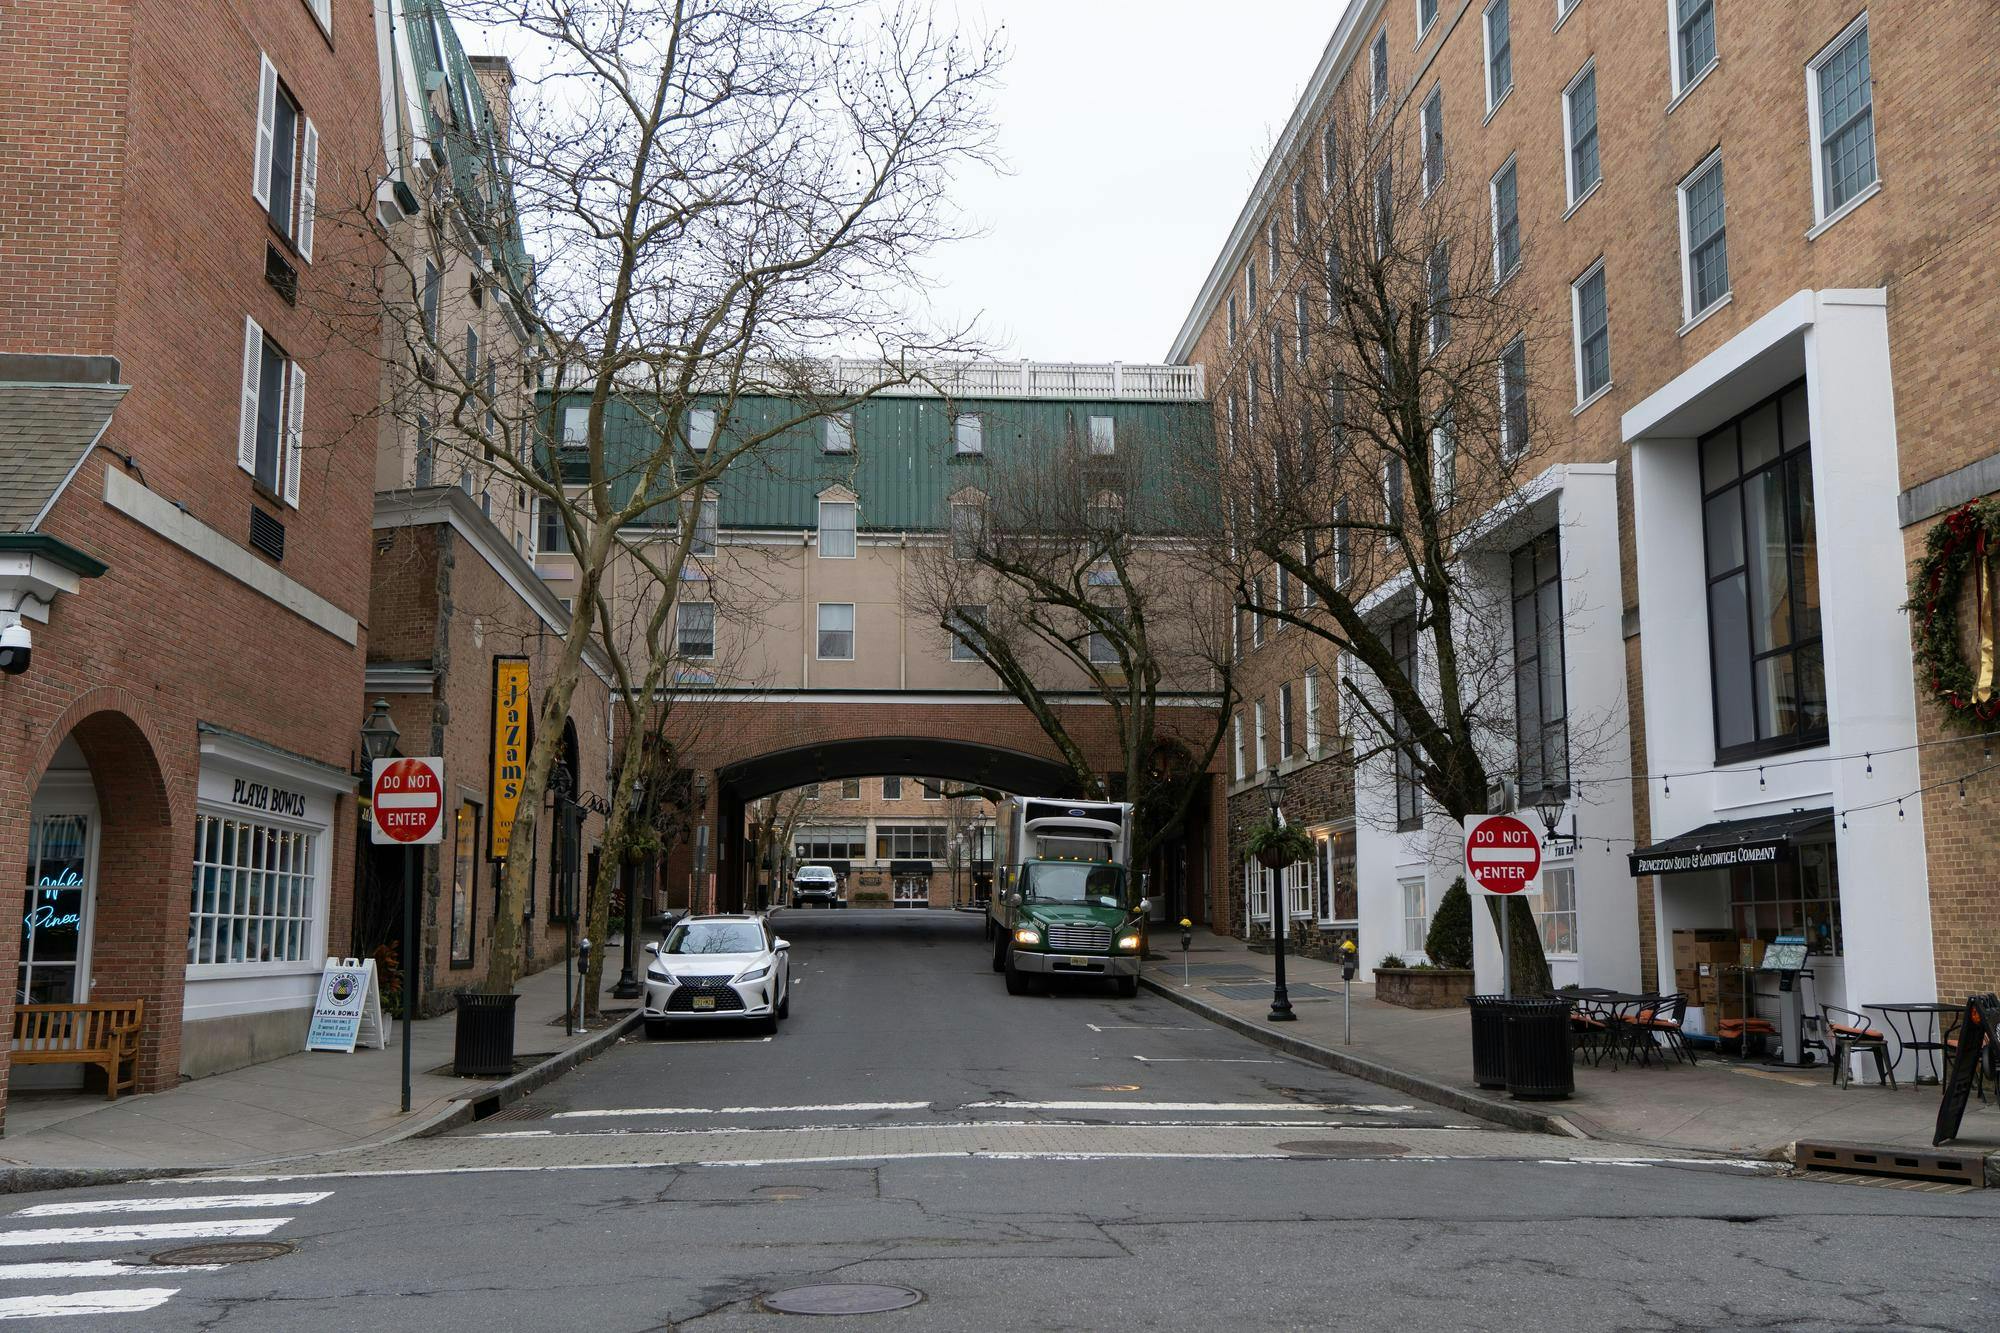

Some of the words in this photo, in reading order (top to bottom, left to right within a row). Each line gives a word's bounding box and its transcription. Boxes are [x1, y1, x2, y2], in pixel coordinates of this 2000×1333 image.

[384, 776, 400, 789] DO
[408, 775, 432, 788] NOT
[232, 778, 268, 810] PLAYA
[270, 788, 306, 817] BOWLS
[387, 812, 427, 826] ENTER
[1476, 831, 1495, 843] DO
[1503, 831, 1529, 843] NOT
[1638, 859, 1675, 872] PRINCETON
[1674, 856, 1691, 870] SOUP
[1691, 855, 1699, 868] &
[1699, 851, 1737, 867] SANDWICH
[1737, 846, 1777, 862] COMPANY
[1483, 866, 1525, 879] ENTER
